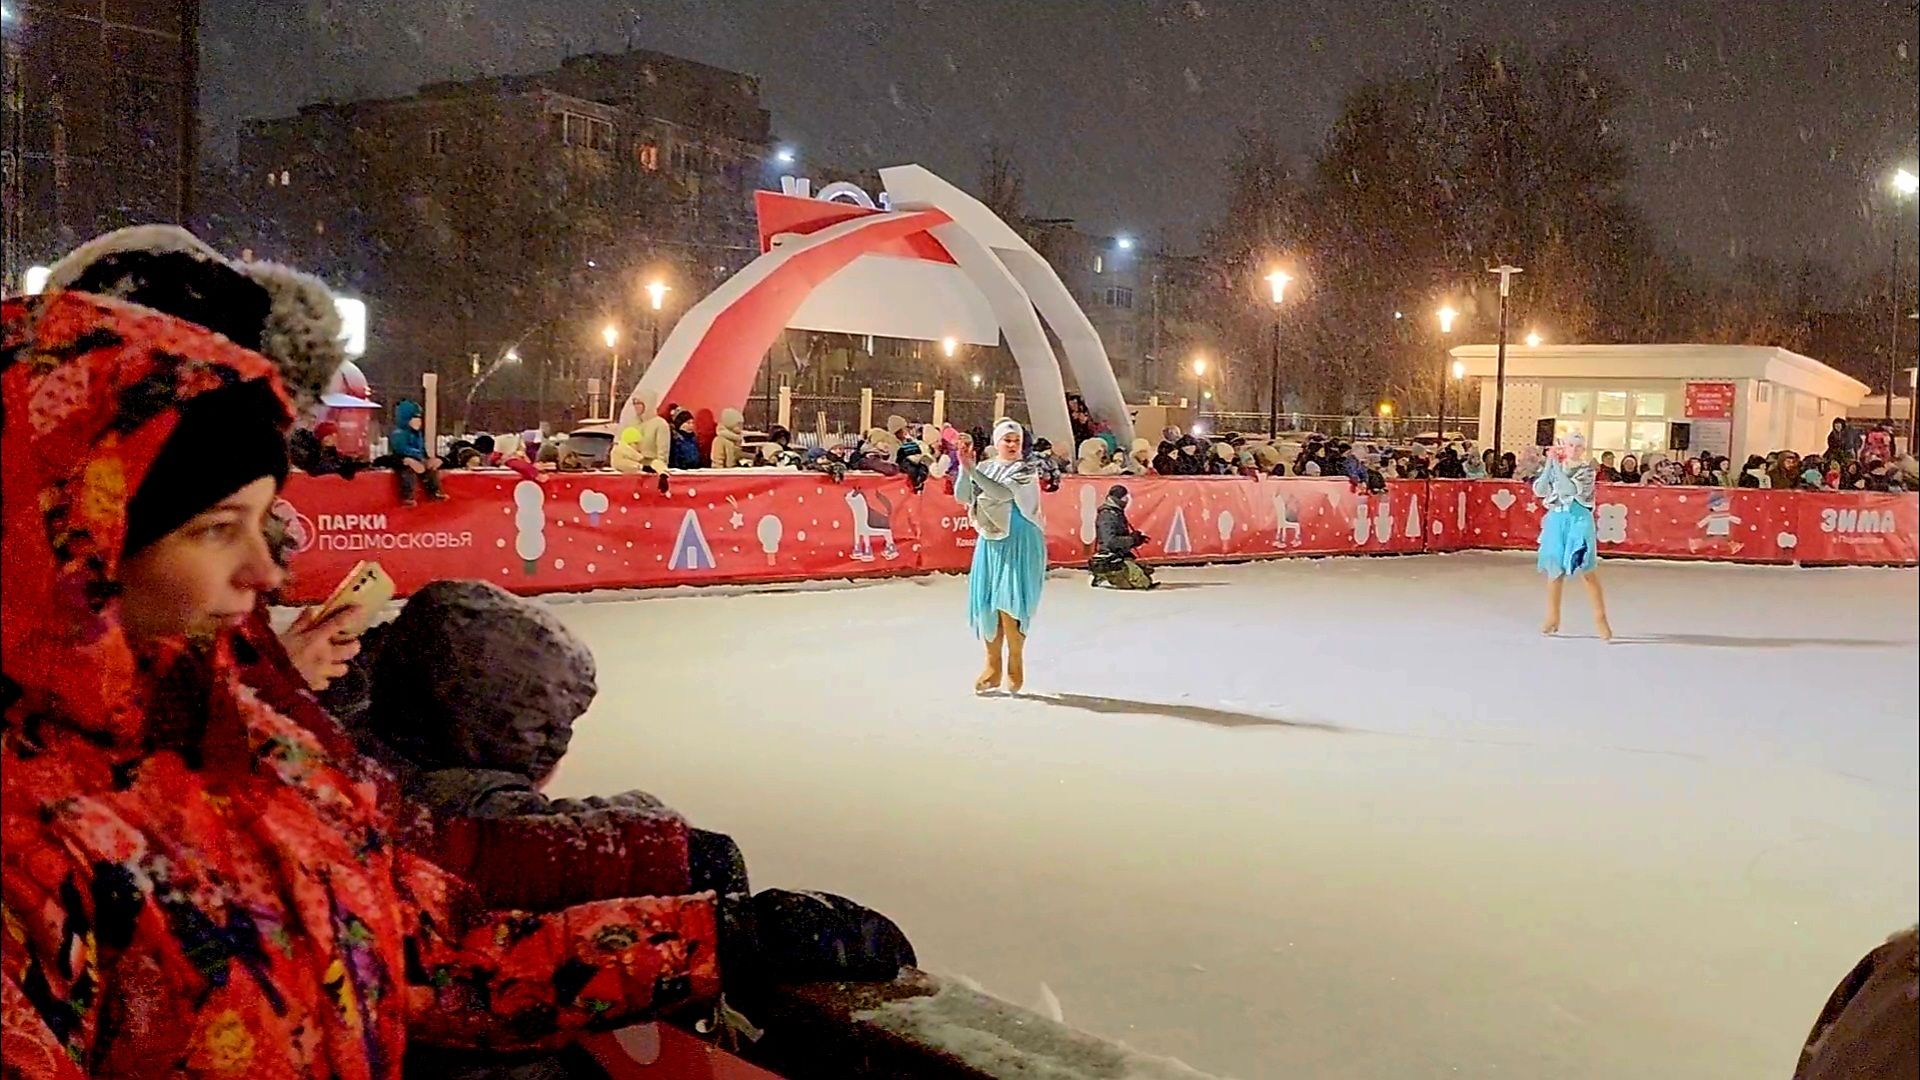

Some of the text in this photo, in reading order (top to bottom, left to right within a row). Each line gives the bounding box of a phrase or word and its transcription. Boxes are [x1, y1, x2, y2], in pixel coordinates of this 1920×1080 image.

[318, 514, 387, 530] ПАРКИ
[1820, 508, 1895, 533] ЗИМА
[319, 531, 472, 550] ПОДМОСКОВЬЯ
